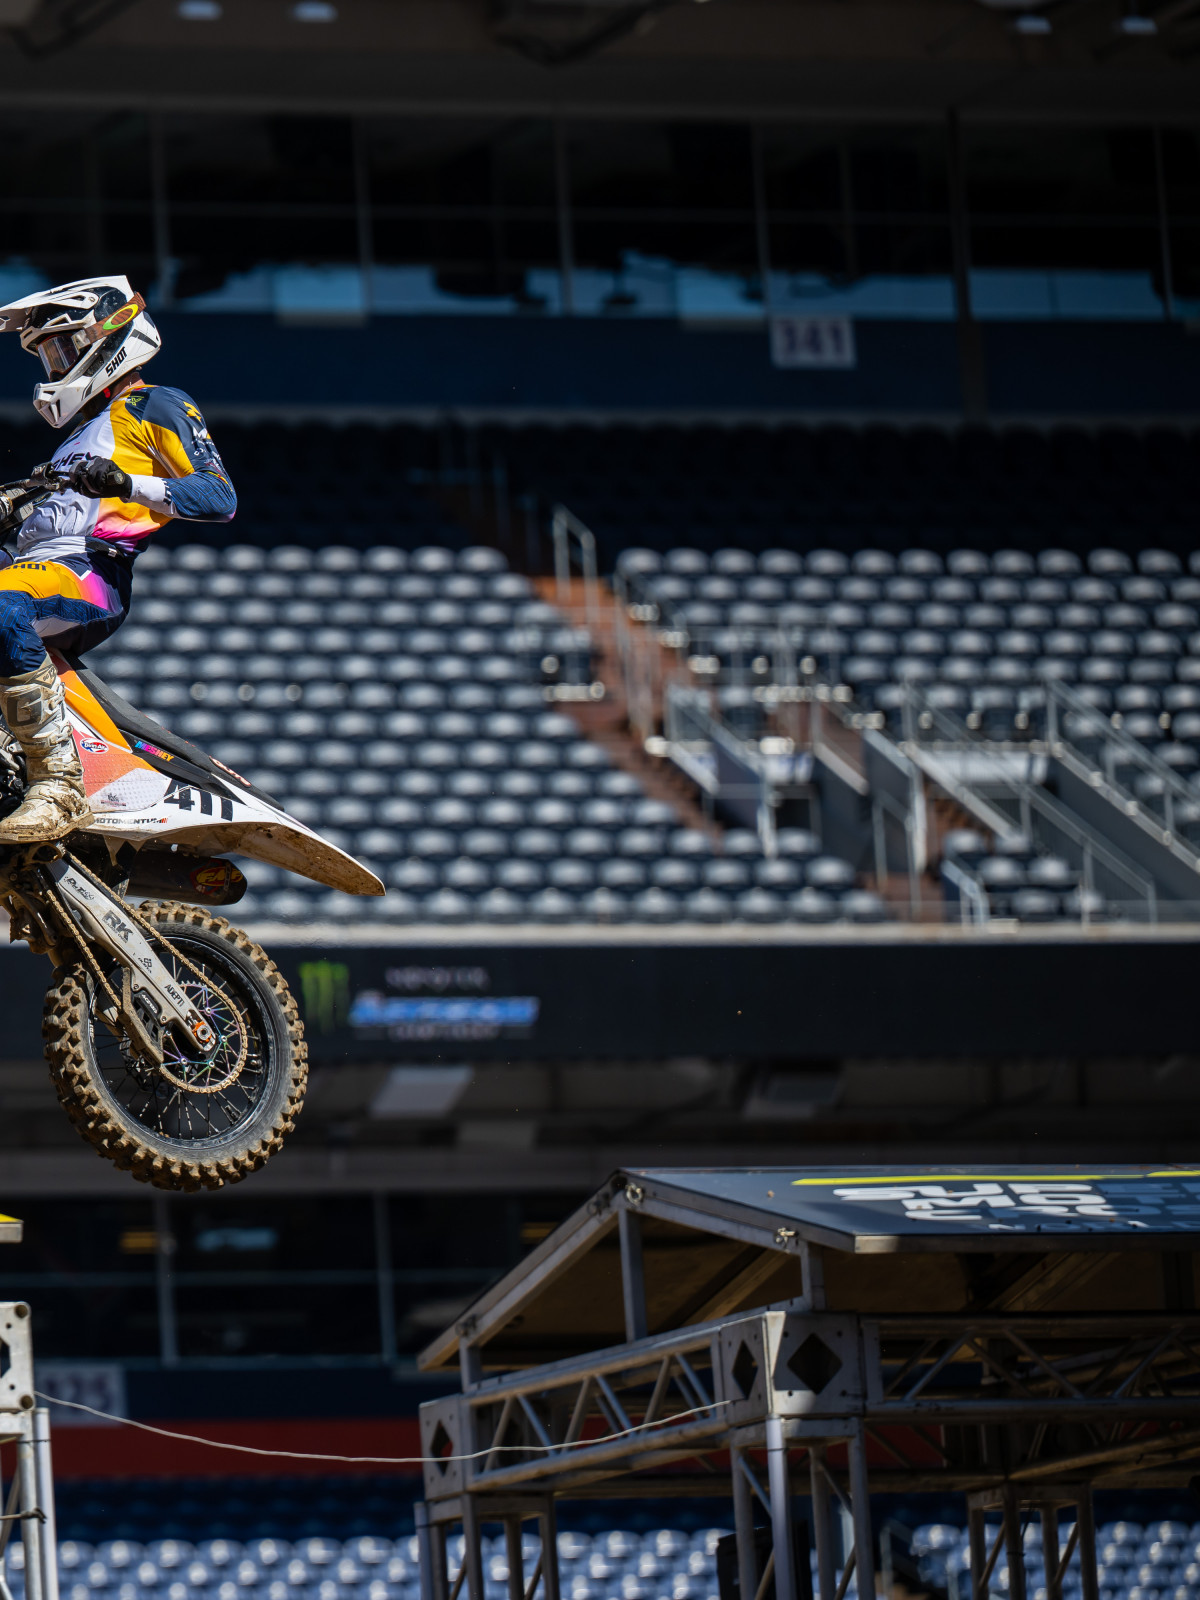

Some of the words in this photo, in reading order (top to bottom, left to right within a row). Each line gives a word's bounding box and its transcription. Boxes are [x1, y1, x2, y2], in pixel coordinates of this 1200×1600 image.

[105, 346, 128, 377] SHOT
[5, 563, 47, 572] HOT
[135, 740, 175, 762] MESHEY
[164, 780, 234, 822] 411
[102, 910, 134, 941] RK
